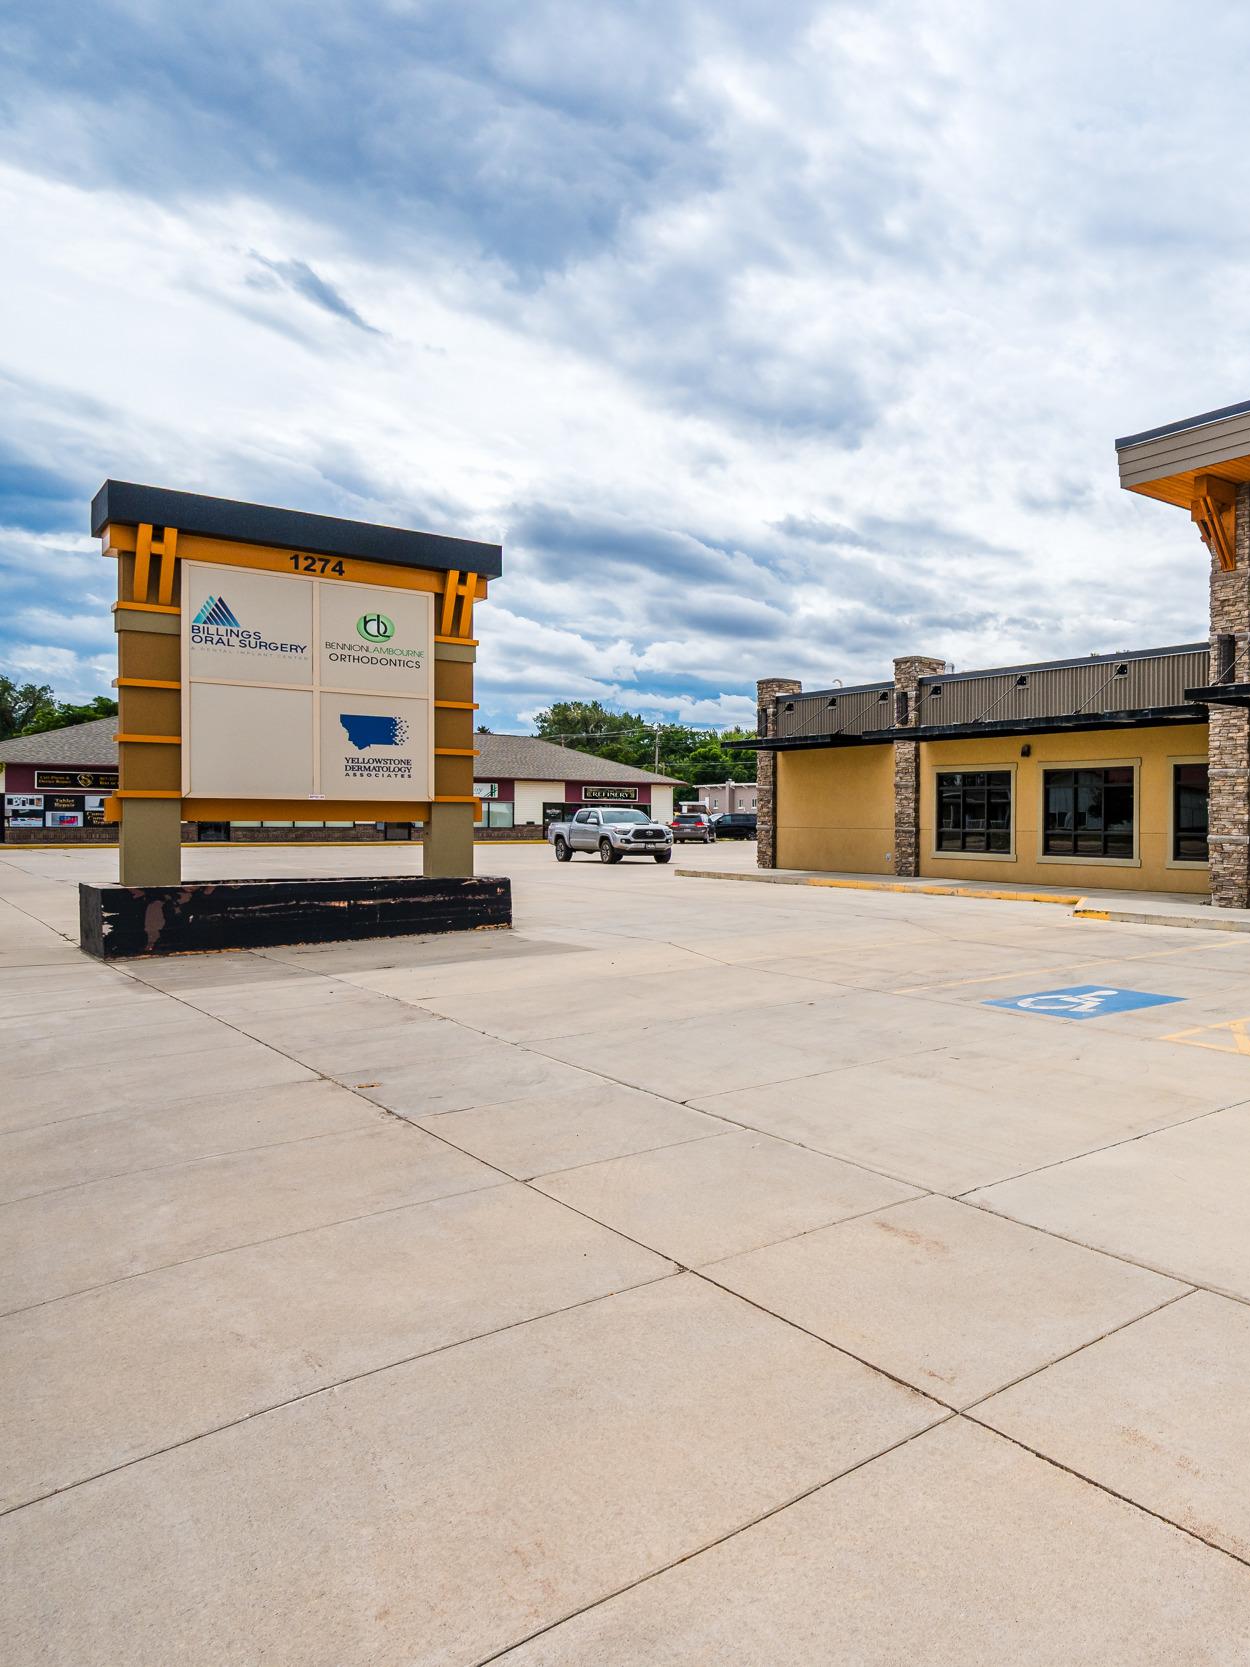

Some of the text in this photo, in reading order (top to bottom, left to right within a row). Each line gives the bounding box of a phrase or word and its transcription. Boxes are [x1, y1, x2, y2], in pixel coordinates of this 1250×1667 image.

[289, 554, 345, 576] 1274
[191, 624, 262, 640] BILLINGS
[191, 635, 307, 654] ORAL SURGERY
[328, 652, 421, 669] ORTHODONTICS
[344, 756, 413, 766] YELLOWSTONE
[344, 764, 413, 774] DERMATOLOGY
